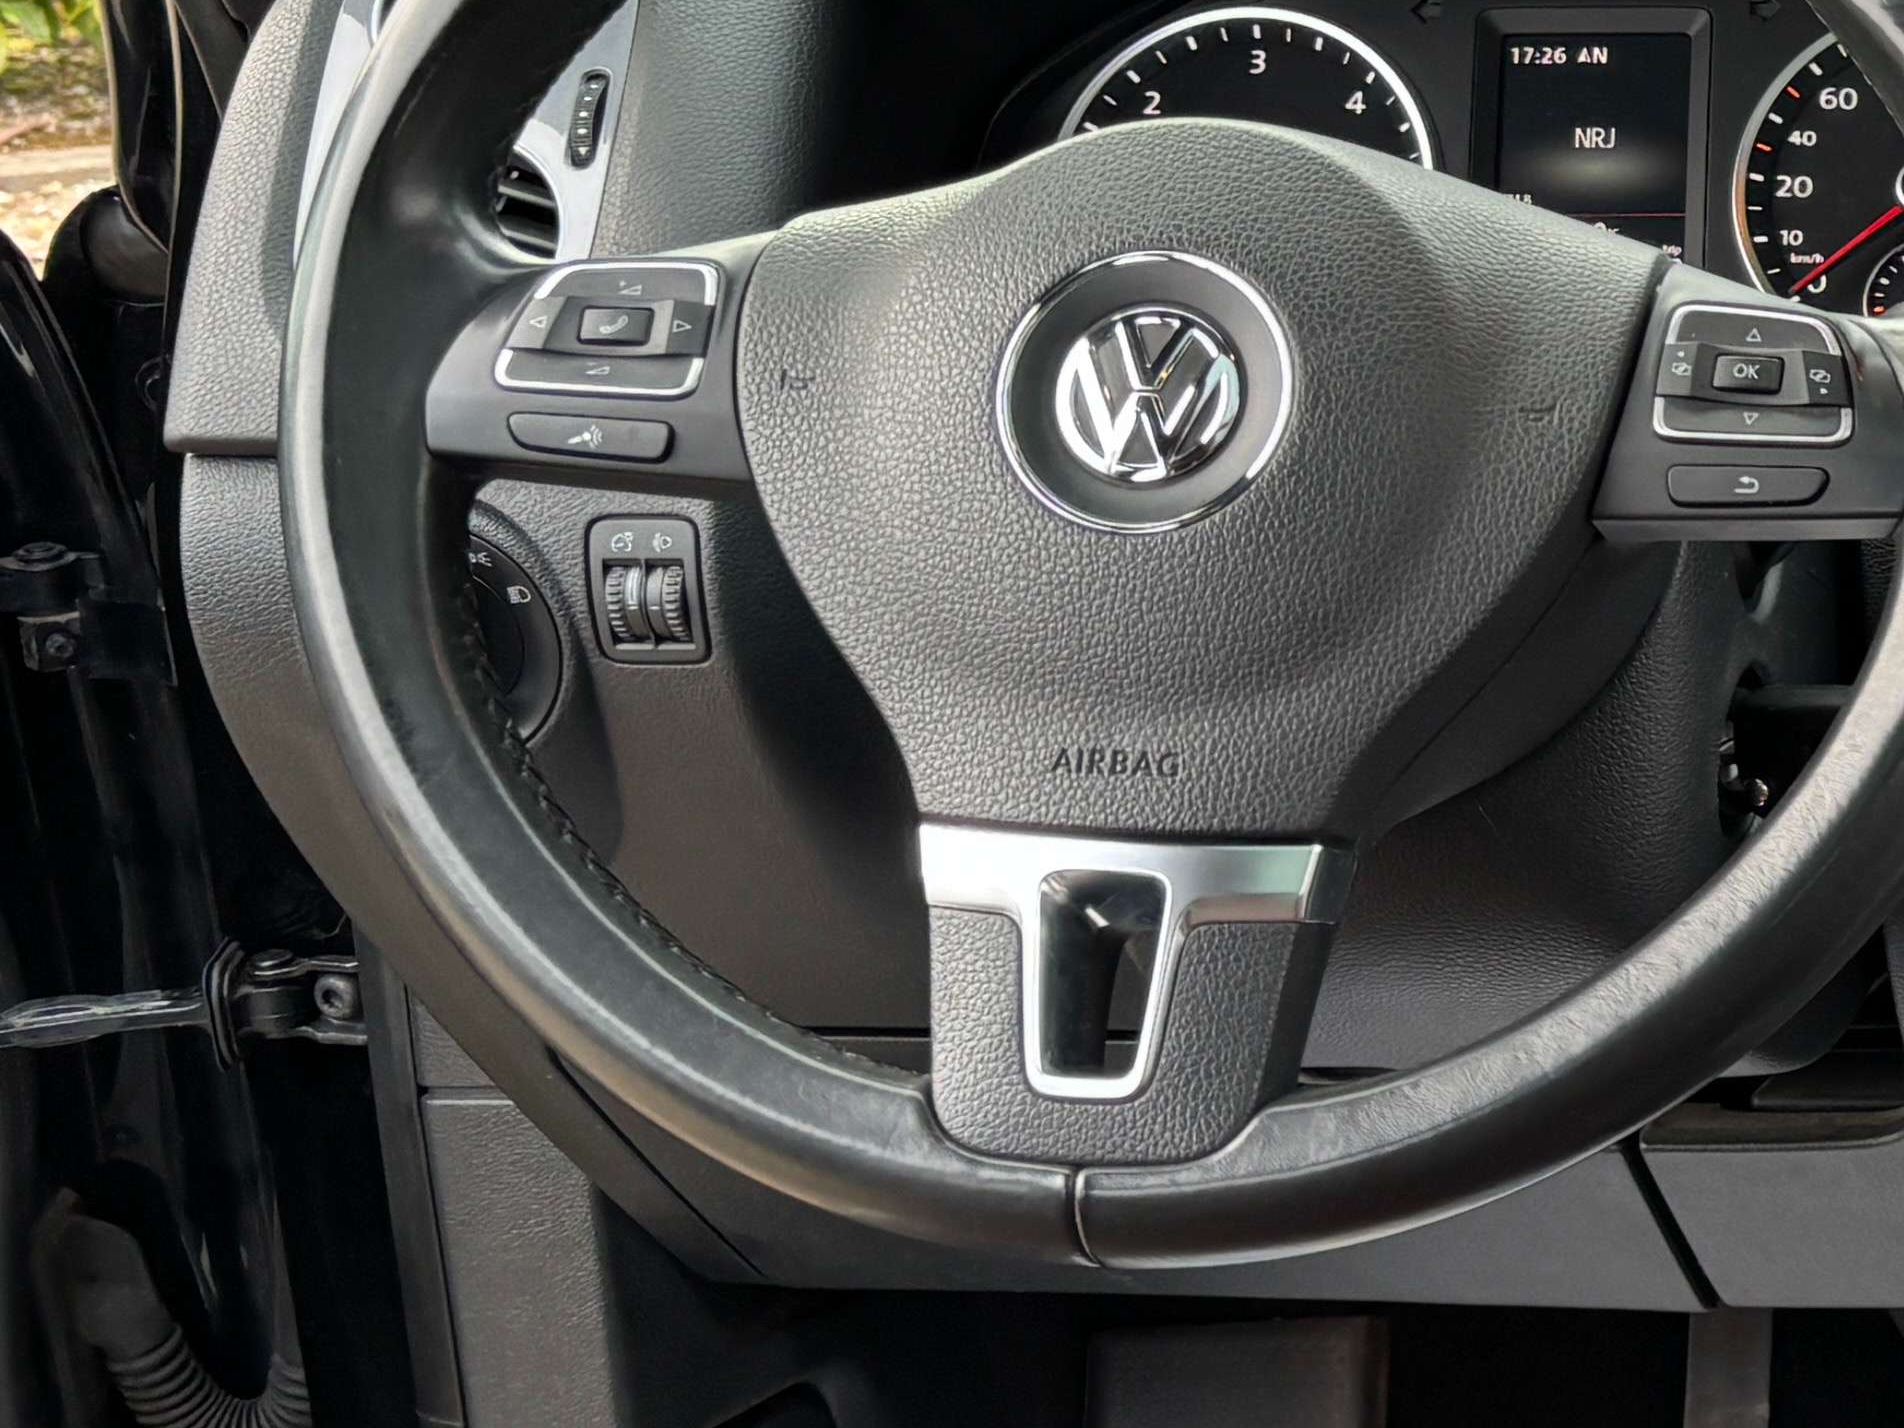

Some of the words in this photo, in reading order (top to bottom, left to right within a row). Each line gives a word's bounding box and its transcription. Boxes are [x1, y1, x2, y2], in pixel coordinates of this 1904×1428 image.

[1249, 49, 1267, 75] 3
[1511, 47, 1567, 64] 17:26
[1142, 90, 1162, 115] 2
[1345, 90, 1367, 115] 4
[1818, 87, 1859, 110] 60
[1574, 127, 1616, 149] NRJ
[1787, 130, 1817, 147] 40
[1775, 175, 1814, 198] 20
[1779, 229, 1803, 247] 10
[1790, 252, 1825, 264] km/h
[1733, 362, 1761, 381] OK
[1050, 746, 1181, 777] AIRBAG
